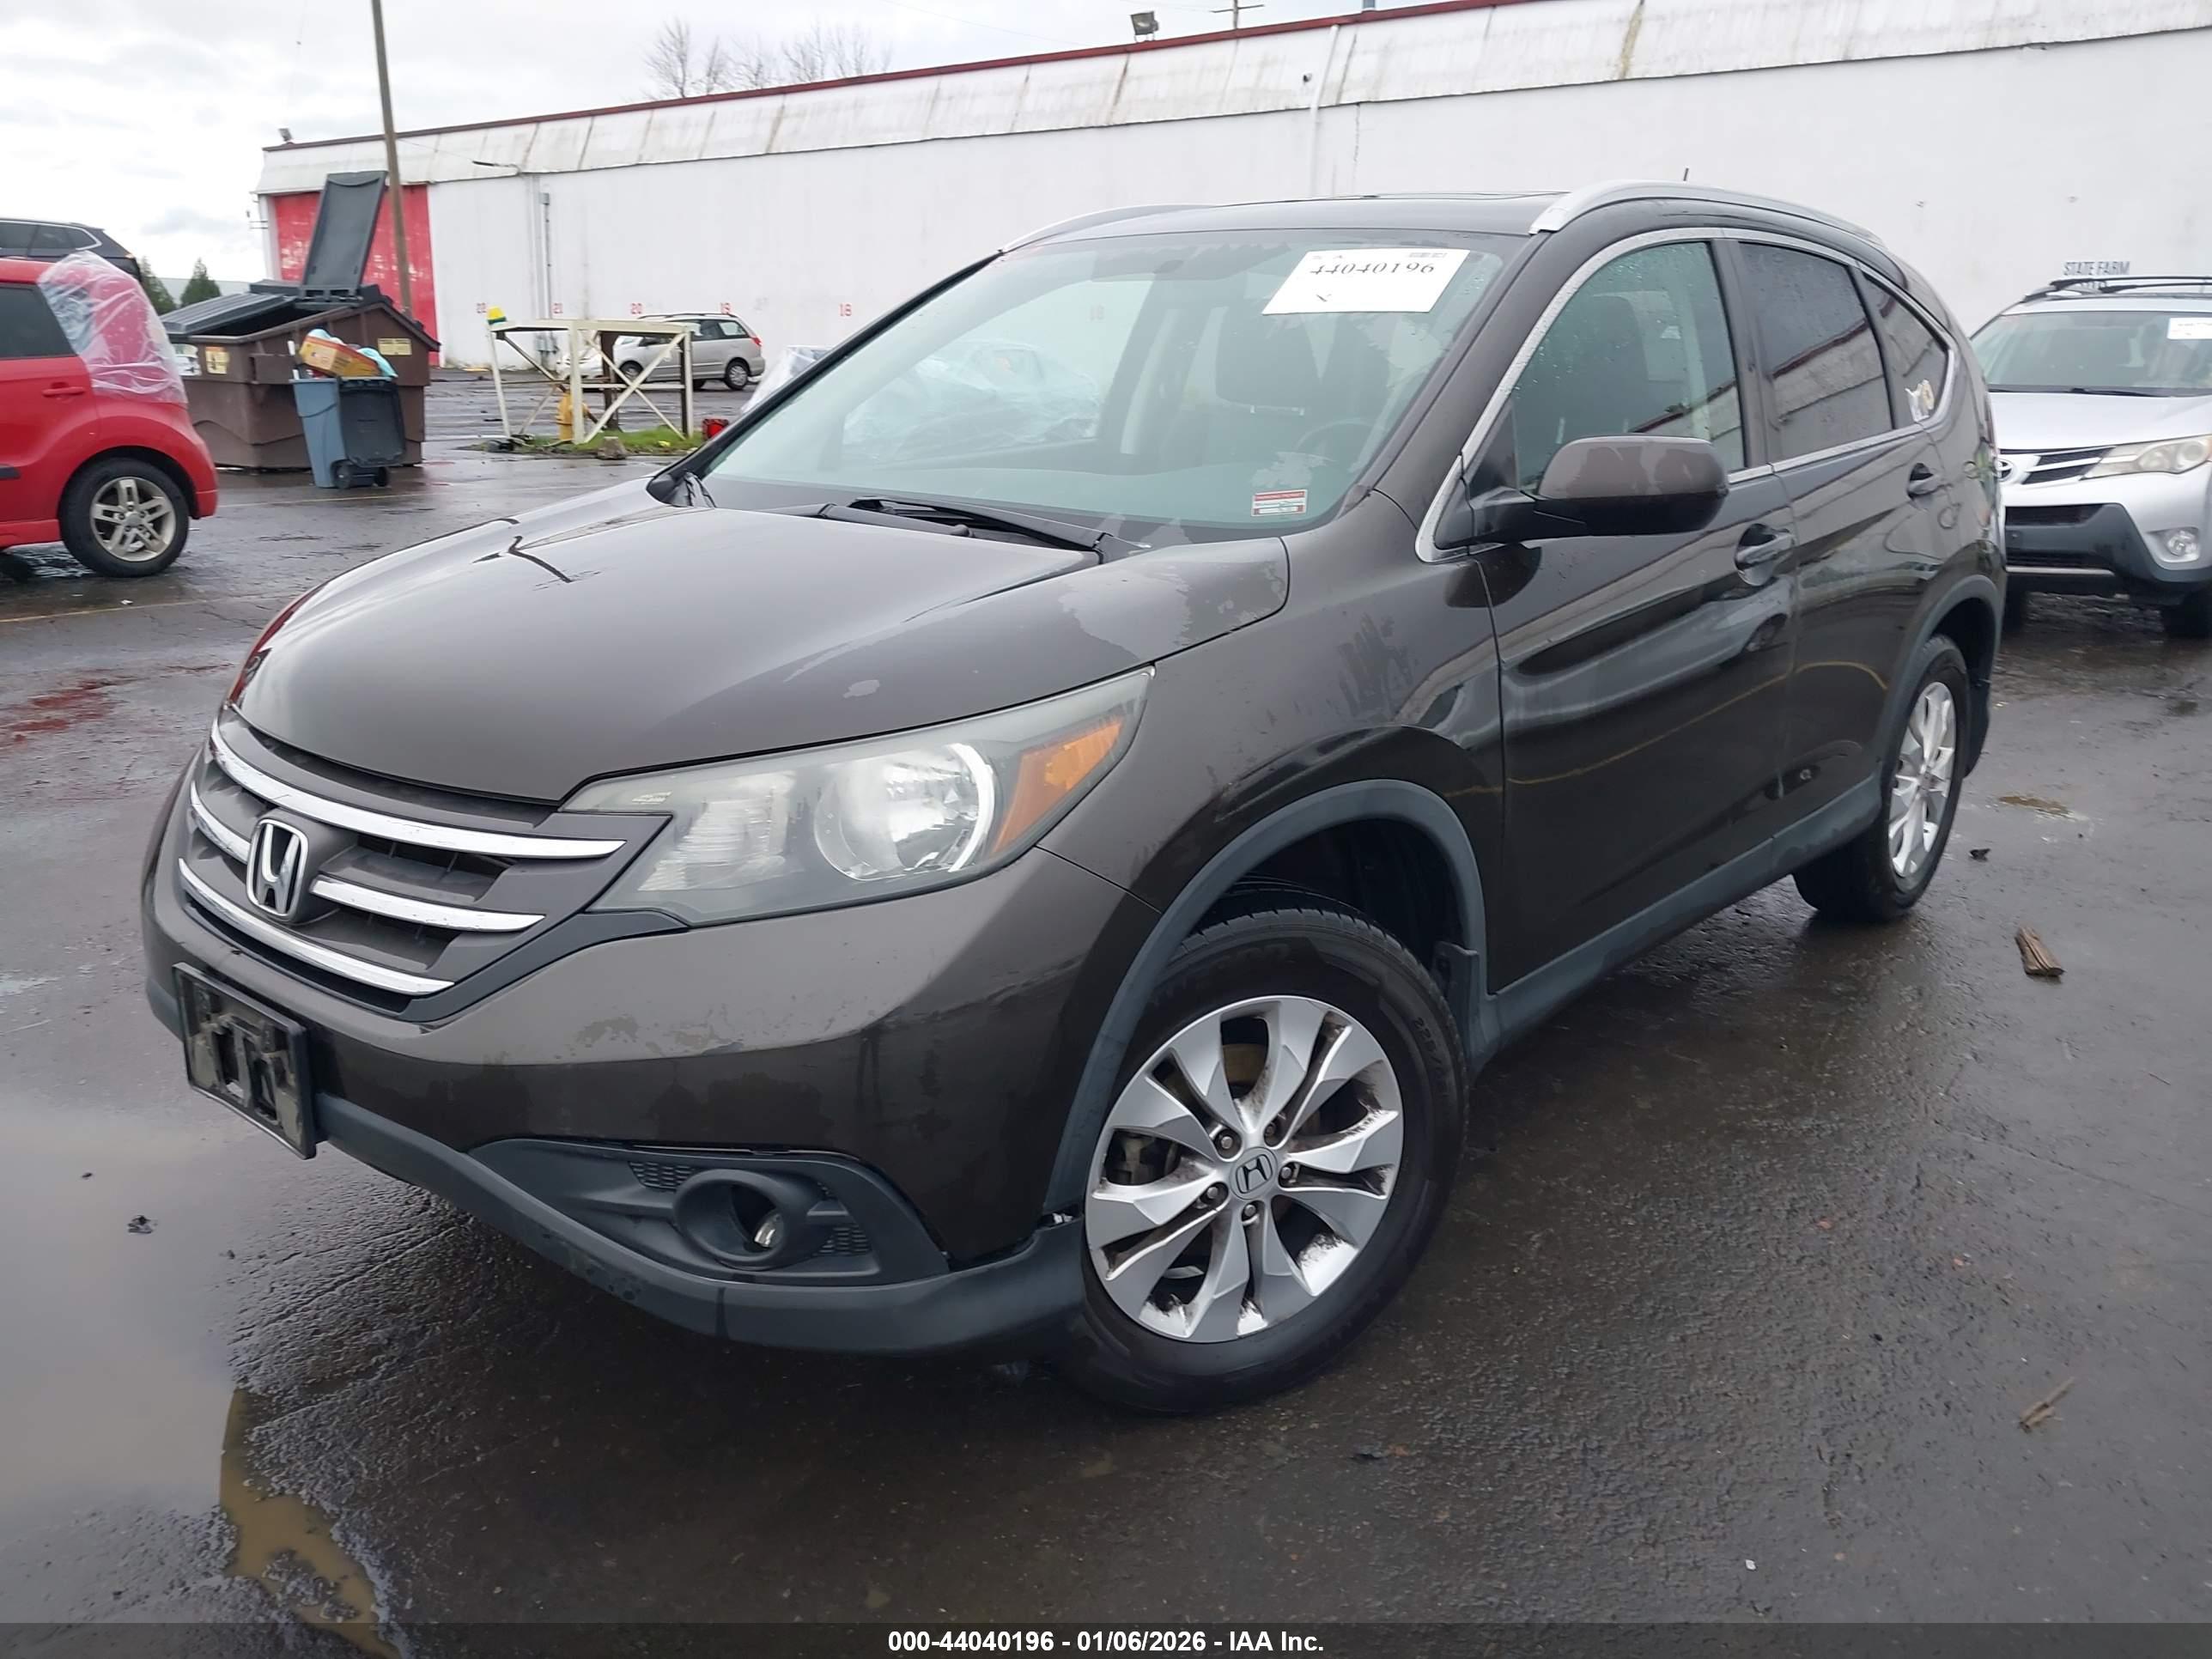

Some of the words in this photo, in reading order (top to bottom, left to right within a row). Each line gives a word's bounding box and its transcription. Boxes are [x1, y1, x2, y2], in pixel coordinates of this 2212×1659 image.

[1310, 261, 1435, 276] 44040196
[2063, 260, 2095, 276] STATE
[2097, 260, 2130, 276] FARM
[631, 302, 643, 315] 20
[839, 303, 853, 317] 18
